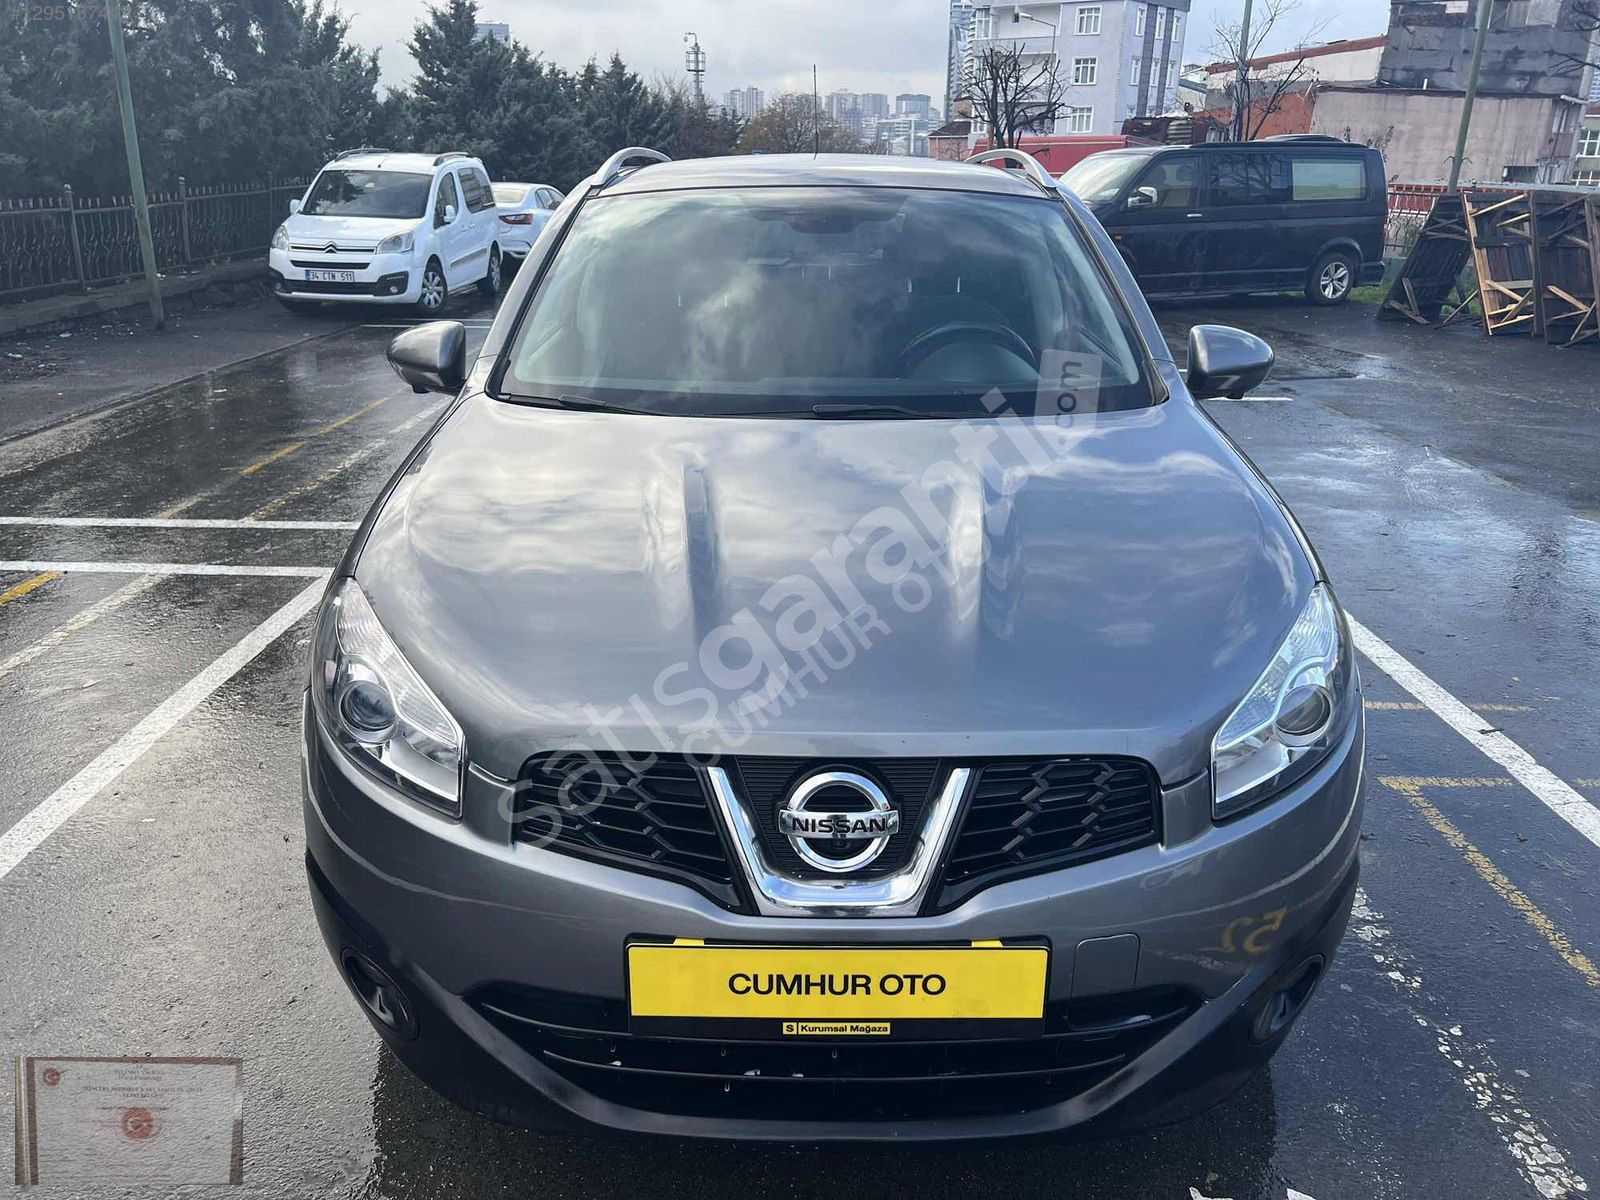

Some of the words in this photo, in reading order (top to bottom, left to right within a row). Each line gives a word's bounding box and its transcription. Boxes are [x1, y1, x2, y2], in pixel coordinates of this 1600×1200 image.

[792, 817, 886, 833] NISSAN
[729, 973, 871, 995] CUMHUR
[879, 973, 946, 995] OTO
[850, 1024, 888, 1033] Mağaza
